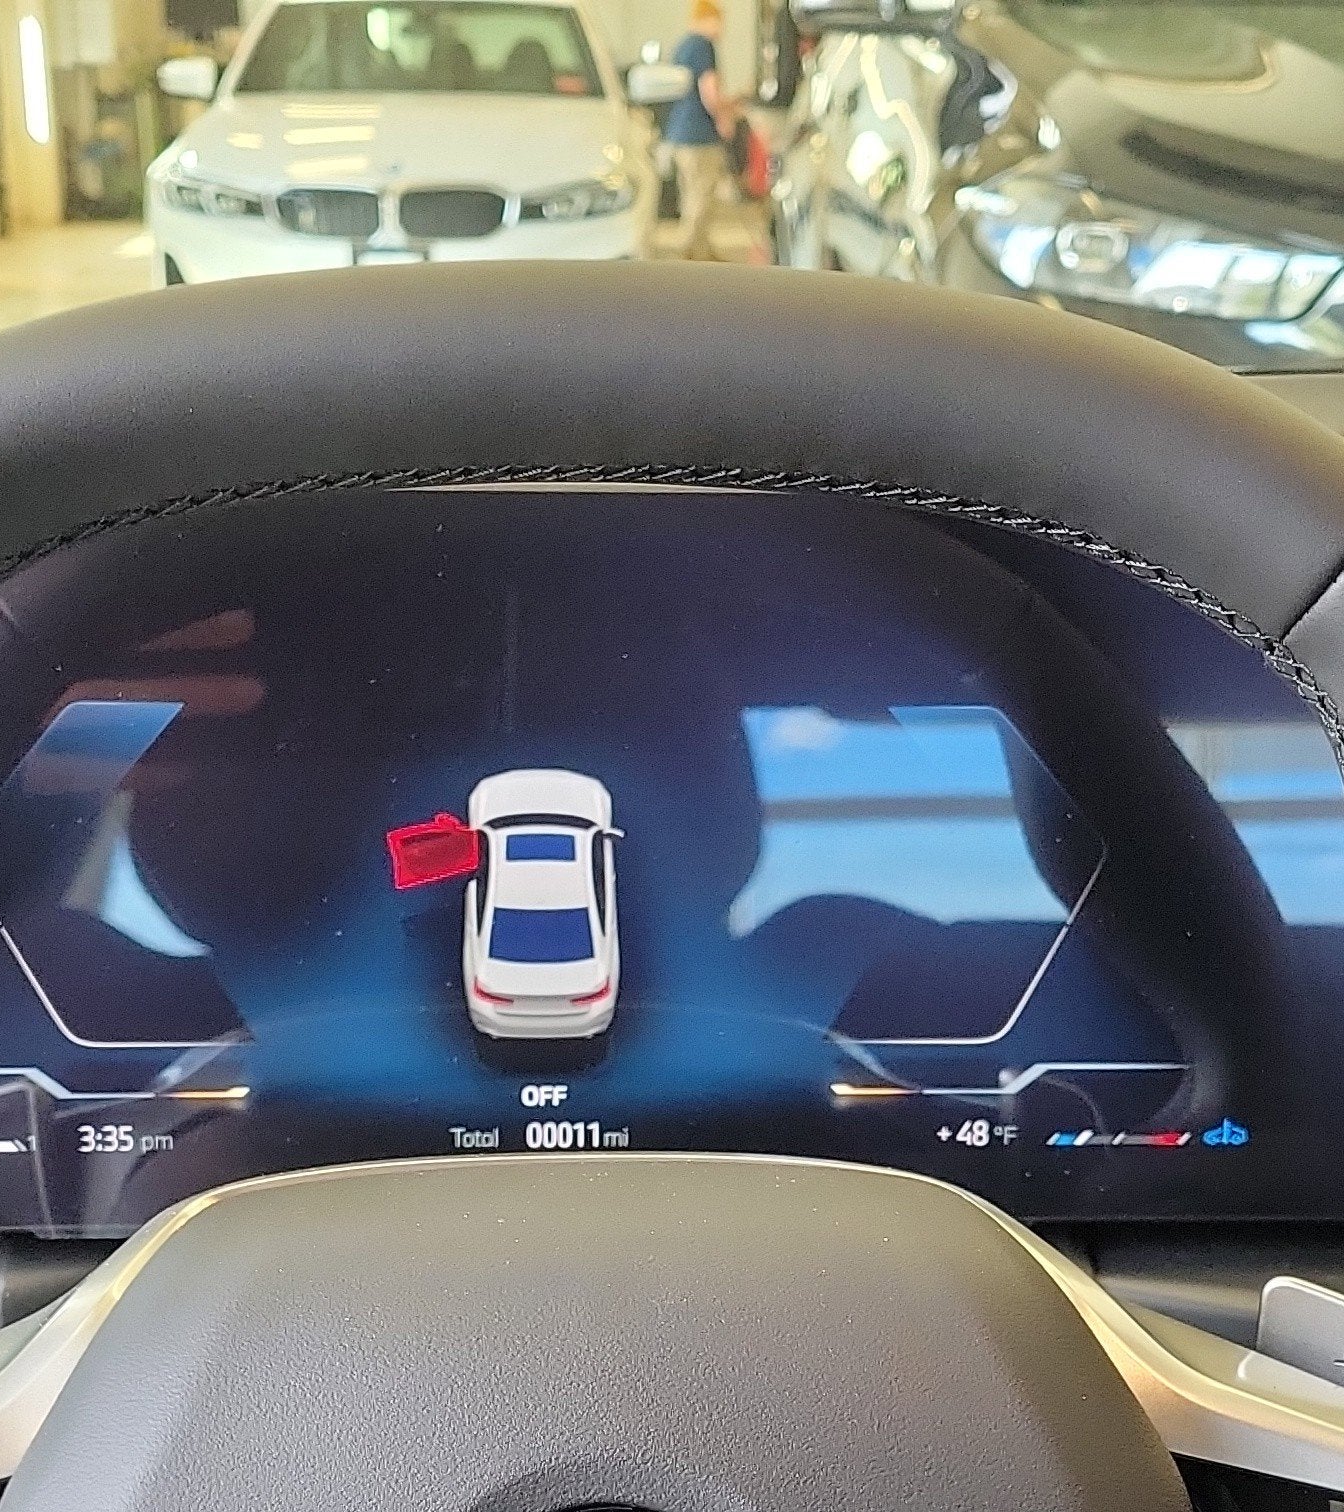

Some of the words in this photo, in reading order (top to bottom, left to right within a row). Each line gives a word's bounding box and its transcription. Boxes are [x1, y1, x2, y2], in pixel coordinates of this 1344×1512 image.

[520, 1084, 568, 1107] OFF
[76, 1125, 135, 1153] 3:35
[140, 1135, 174, 1154] pm
[448, 1126, 500, 1148] Total
[525, 1121, 600, 1149] 00011
[602, 1126, 630, 1148] mi
